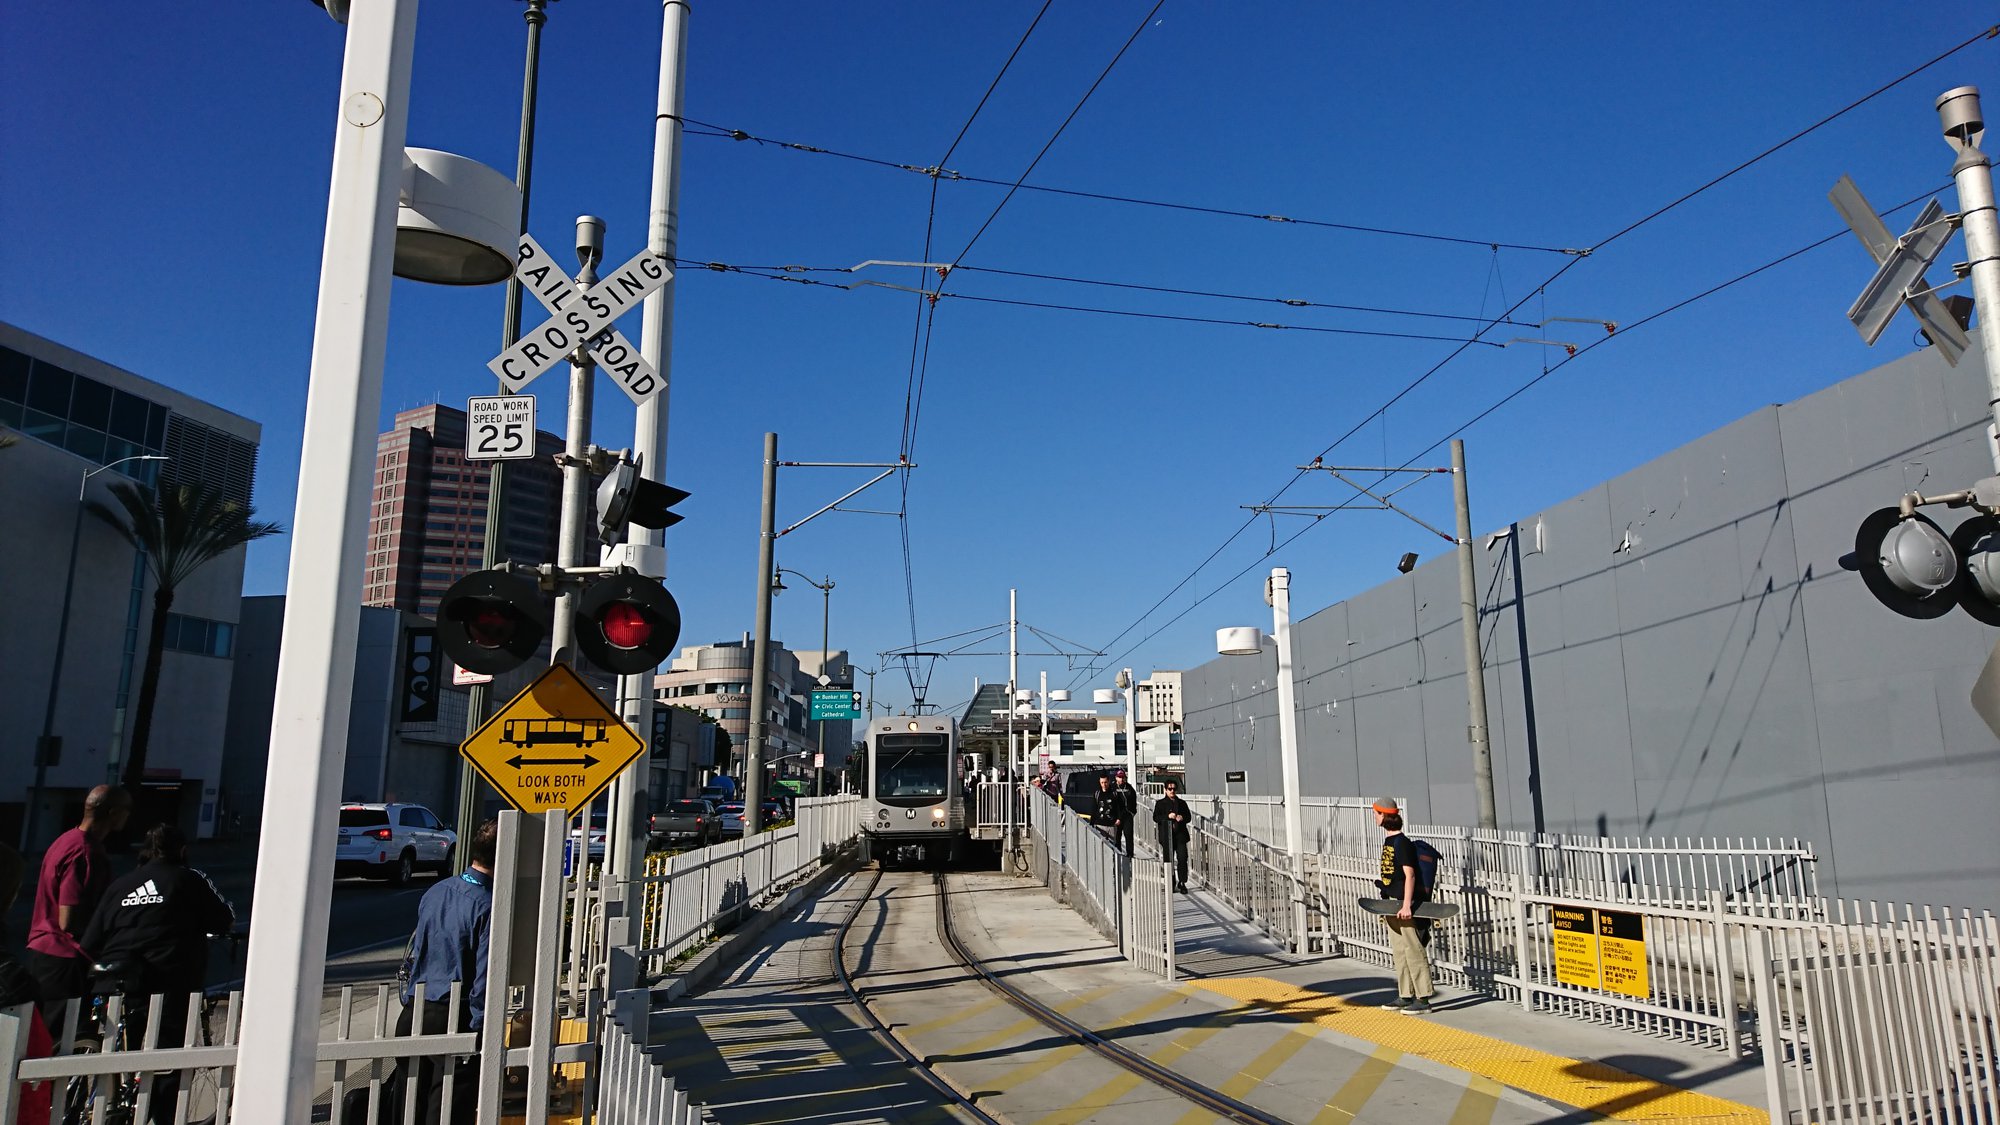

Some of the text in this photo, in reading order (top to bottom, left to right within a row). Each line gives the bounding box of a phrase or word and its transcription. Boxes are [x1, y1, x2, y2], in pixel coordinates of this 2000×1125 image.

[502, 258, 662, 381] CROSSING
[519, 242, 656, 396] RAIL ROAD
[474, 400, 529, 412] ROAD WORK
[473, 413, 529, 424] SPEED LIMIT
[477, 424, 523, 453] 25
[518, 775, 586, 787] LOOK BOTH
[534, 792, 567, 804] WAYS
[121, 894, 164, 906] adidas
[1555, 910, 1585, 921] WARNING
